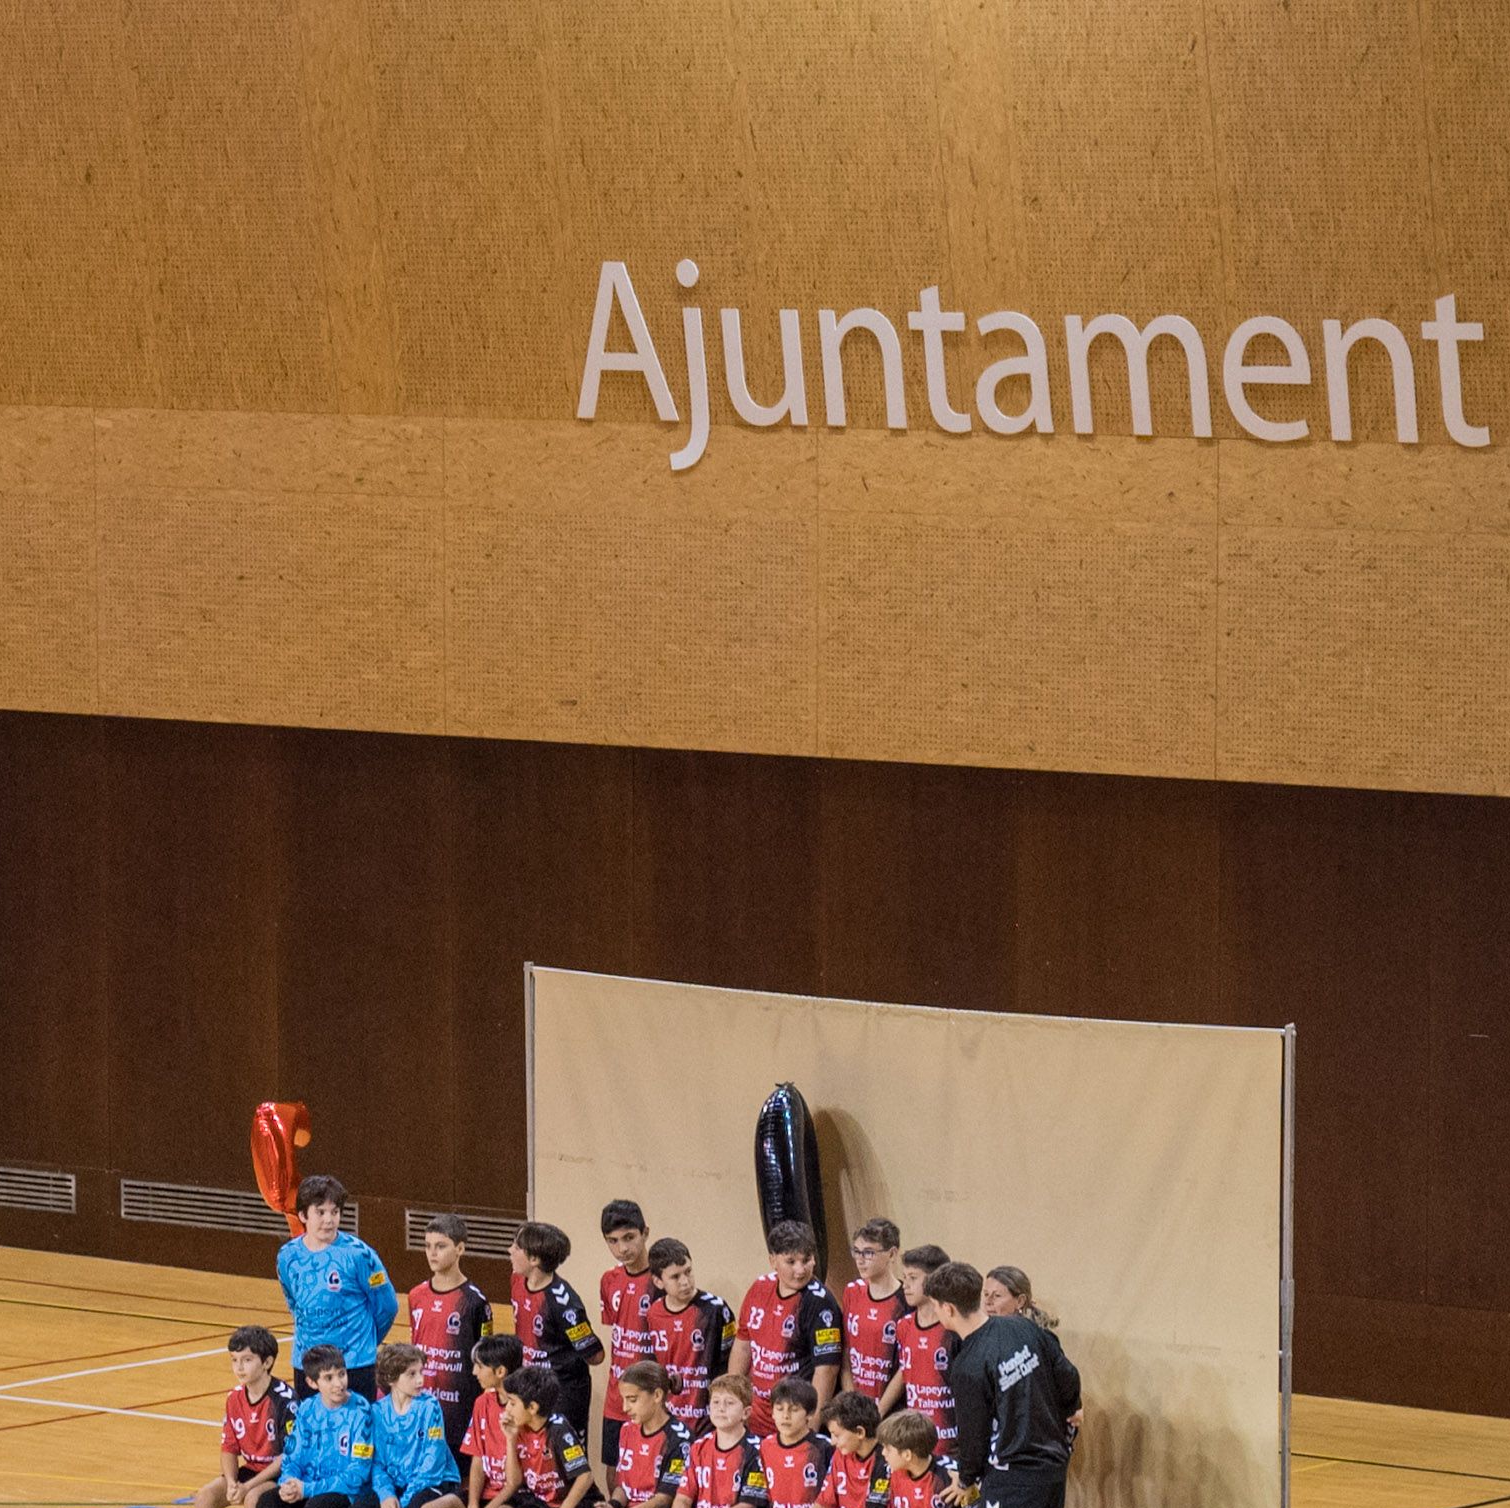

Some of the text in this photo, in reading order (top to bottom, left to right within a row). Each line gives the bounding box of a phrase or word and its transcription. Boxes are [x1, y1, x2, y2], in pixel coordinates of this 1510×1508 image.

[577, 259, 1490, 470] Ajuntament
[424, 1344, 461, 1360] Lapeyra
[761, 1346, 796, 1362] Lapeyra
[760, 1360, 800, 1374] Taltavull
[695, 1466, 711, 1488] 10
[837, 1471, 847, 1495] 2
